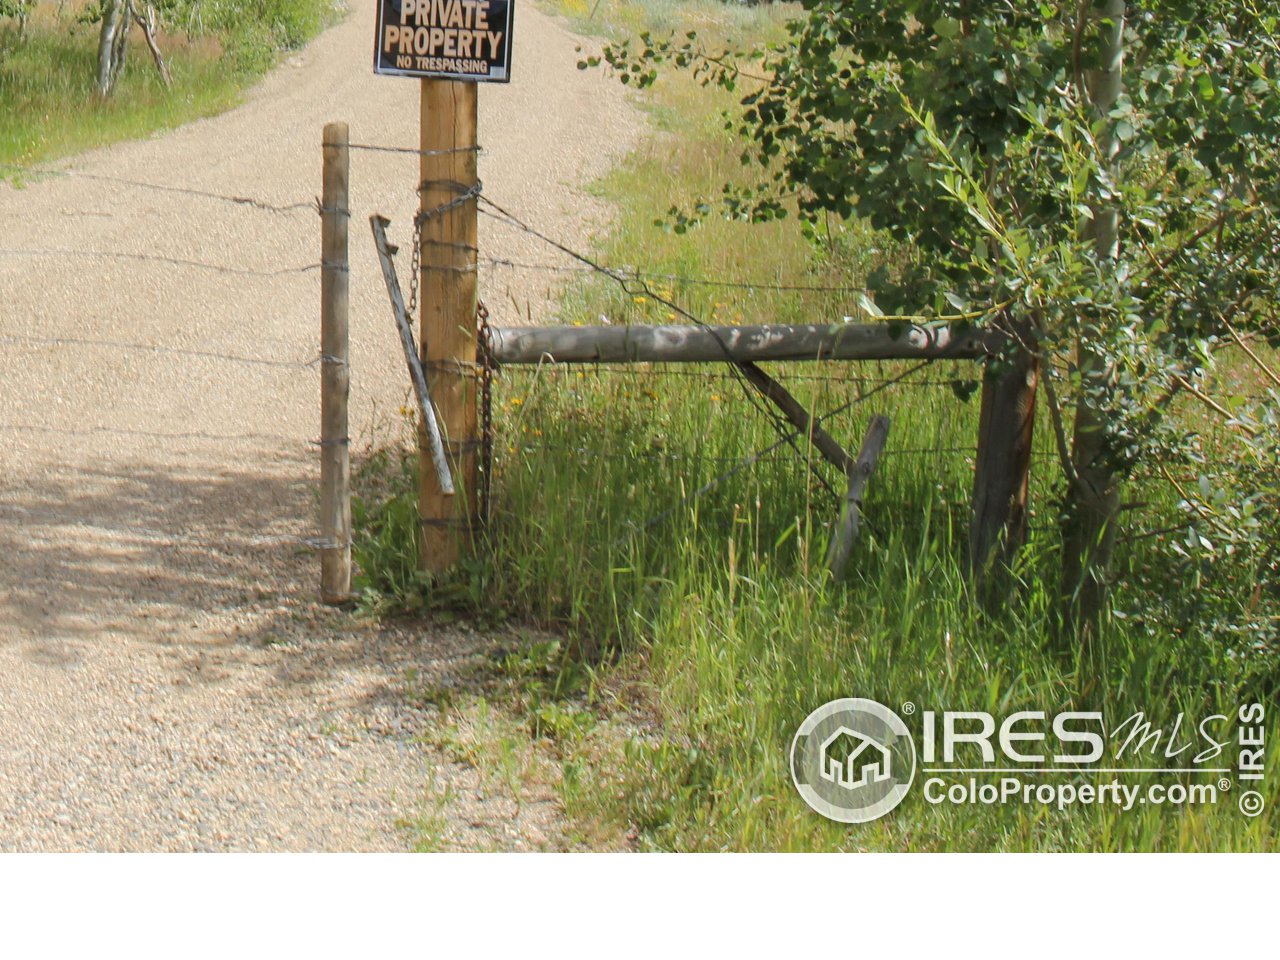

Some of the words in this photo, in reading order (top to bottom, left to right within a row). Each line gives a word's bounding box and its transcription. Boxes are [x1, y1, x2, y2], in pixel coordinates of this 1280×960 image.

[384, 24, 503, 59] PROPERTY
[396, 55, 412, 69] NO
[415, 56, 488, 74] TRESPASSING
